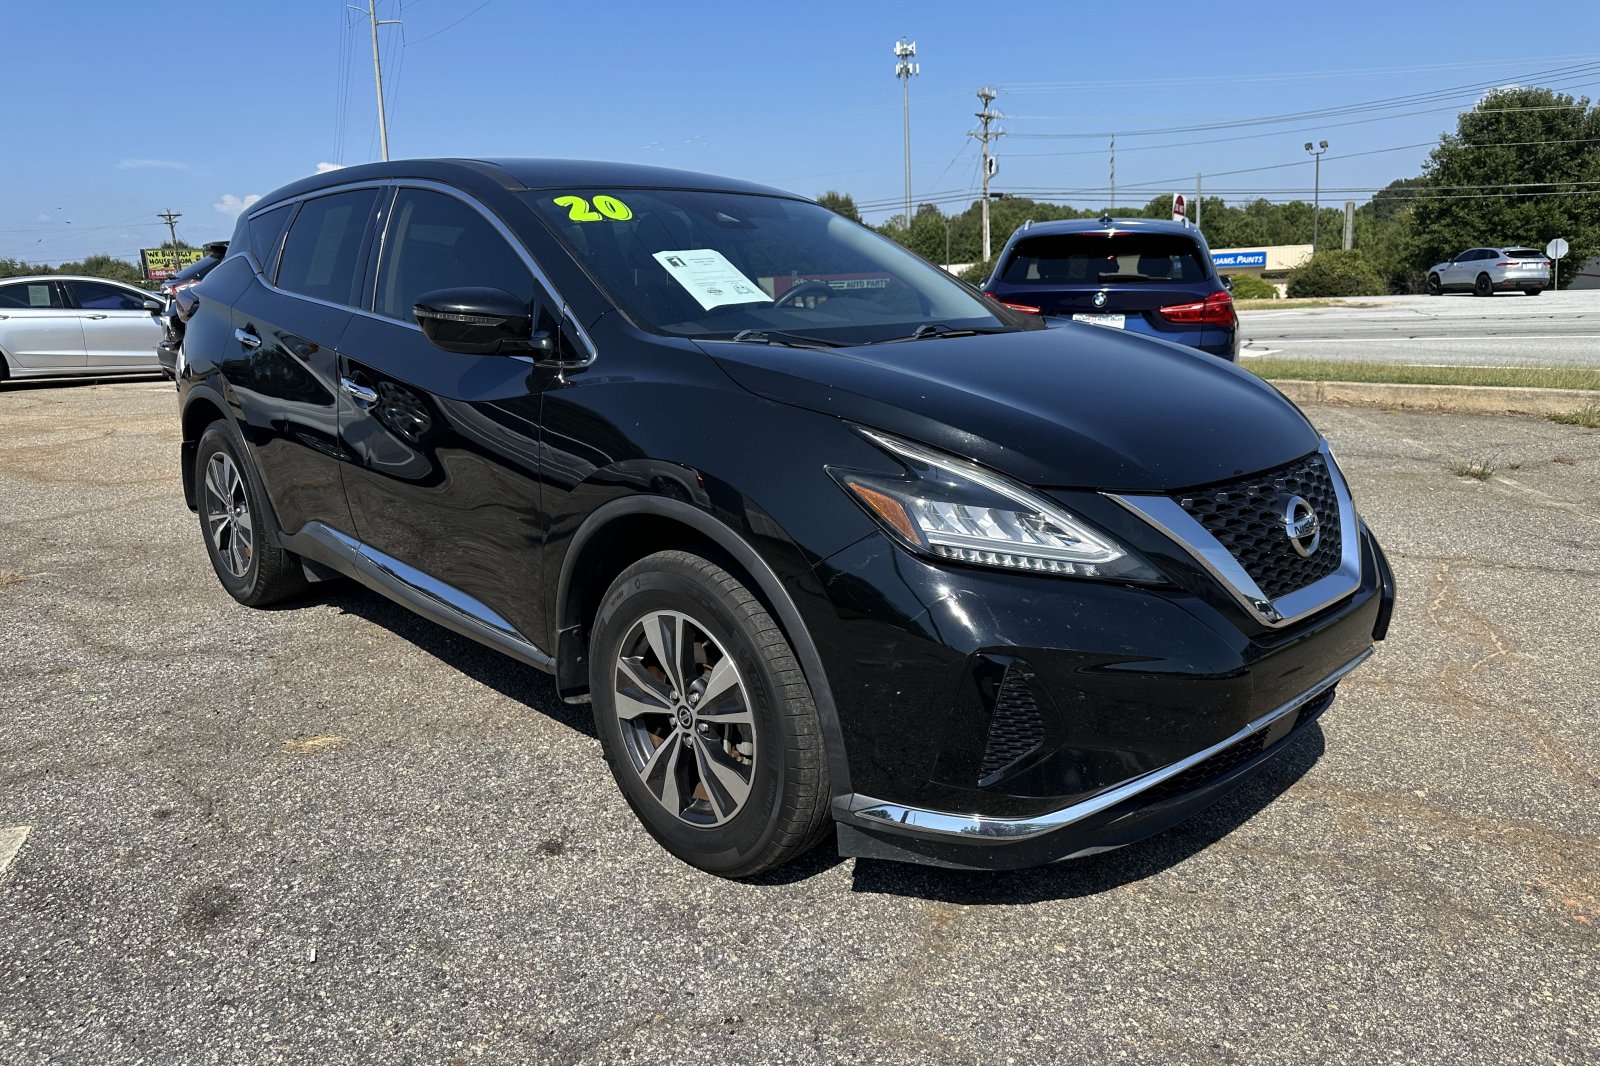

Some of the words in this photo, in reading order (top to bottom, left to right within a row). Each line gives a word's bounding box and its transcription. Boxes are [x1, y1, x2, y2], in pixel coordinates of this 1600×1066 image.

[553, 195, 633, 221] 20
[1236, 256, 1263, 264] PAINTS
[846, 280, 865, 289] AUTO
